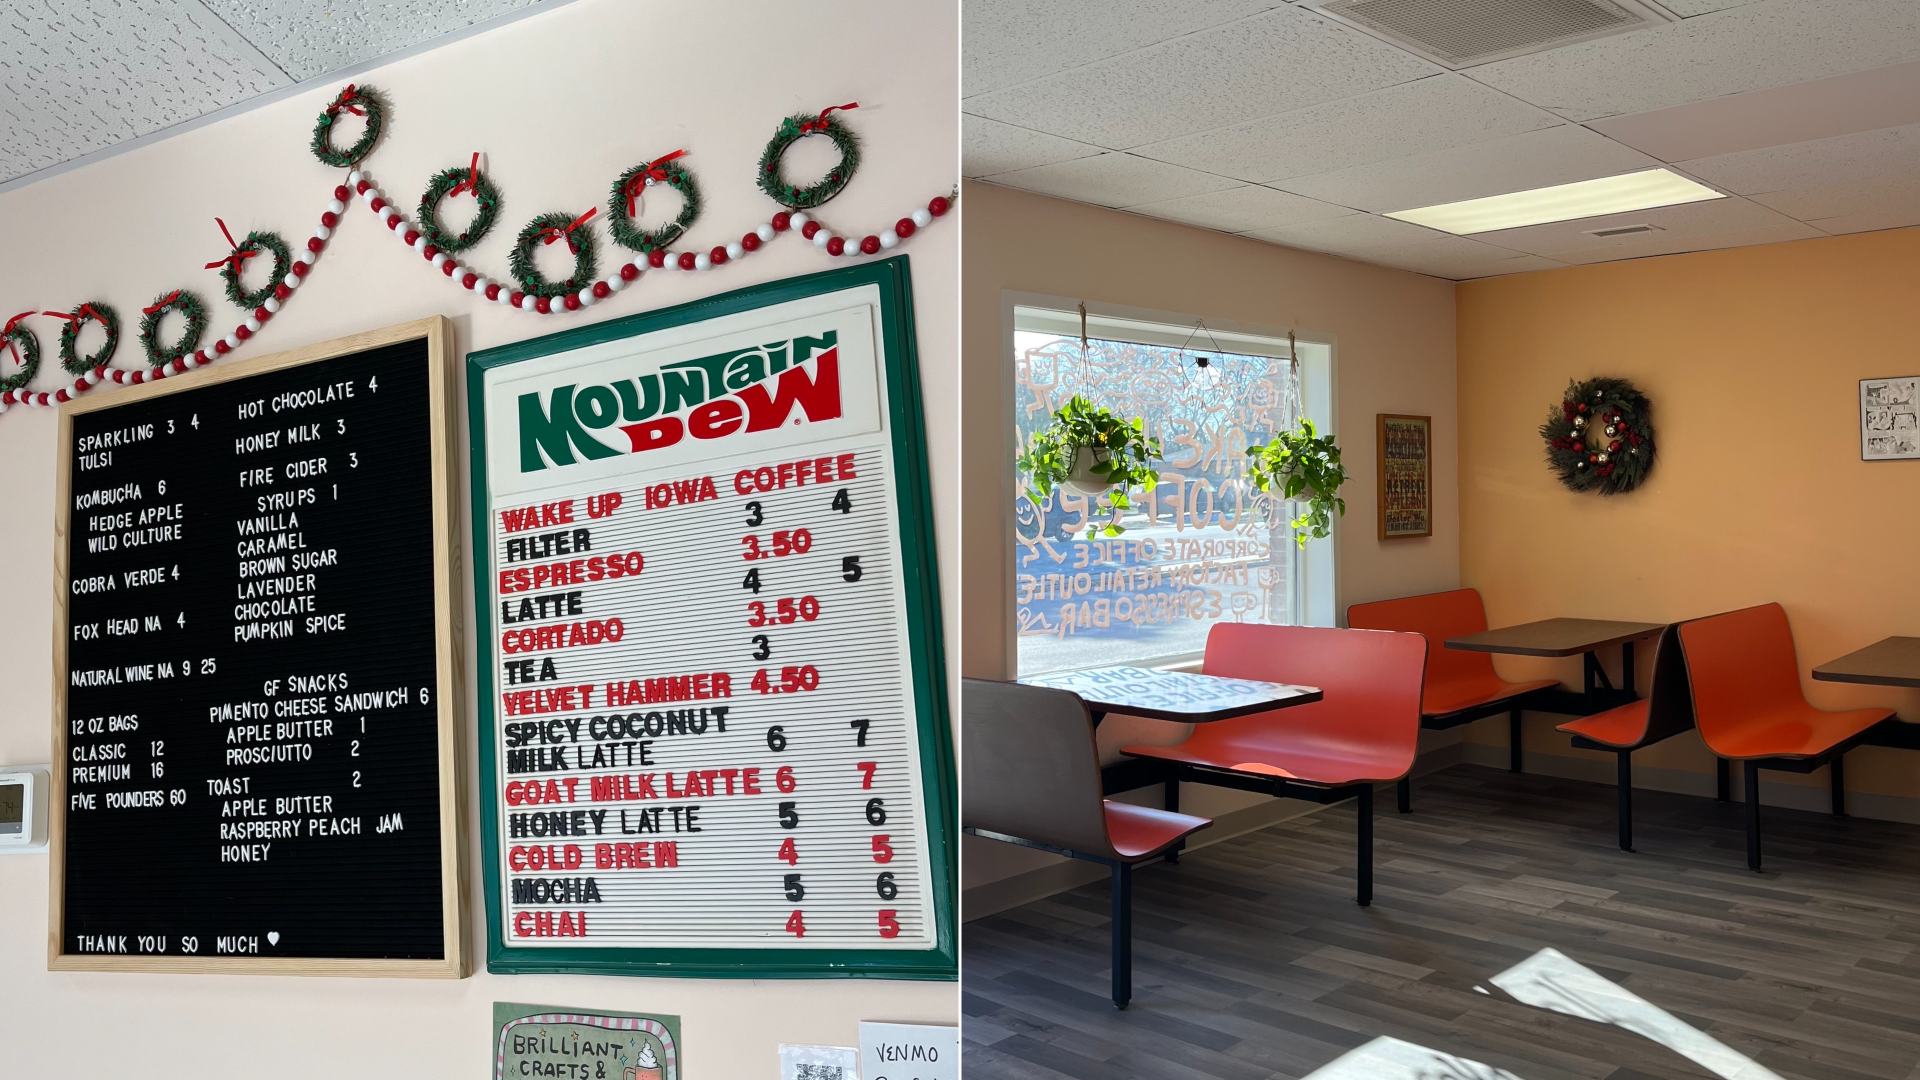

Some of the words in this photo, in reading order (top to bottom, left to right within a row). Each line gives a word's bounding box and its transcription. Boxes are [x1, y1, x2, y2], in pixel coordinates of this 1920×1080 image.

[239, 399, 264, 419] HOT
[272, 381, 354, 412] CHOCOLATE
[369, 376, 377, 392] 4
[79, 424, 153, 452] SPARKLING
[168, 420, 174, 434] 3
[191, 414, 199, 429] 4
[236, 430, 280, 454] HONEY
[288, 424, 320, 444] MILK
[338, 419, 345, 434] 3
[79, 451, 111, 471] TULSI
[240, 467, 273, 487] FIRE
[286, 458, 327, 478] CIDER
[350, 453, 358, 468] 3
[77, 483, 141, 510] KOMBUCHA
[159, 480, 165, 495] 6
[258, 488, 315, 512] SYRUPS
[333, 484, 336, 500] 1
[502, 500, 573, 533] WAKE
[588, 493, 622, 519] UP
[646, 477, 717, 510] IOWA
[734, 453, 856, 496] COFFEE
[90, 512, 132, 531] HEDGE
[139, 504, 183, 525] APPLE
[237, 512, 298, 536] VANILLA
[507, 528, 591, 562] FILTER
[746, 502, 763, 527] 3
[832, 489, 851, 514] 4
[88, 535, 117, 553] WILD
[123, 524, 181, 548] CULTURE
[238, 532, 307, 558] CARAMEL
[240, 556, 285, 578] BROWN
[292, 549, 337, 571] SUGAR
[499, 551, 644, 594] ESPRESSO
[743, 529, 811, 561] 3.50
[73, 575, 115, 594] COBRA
[124, 568, 165, 588] VERDE
[172, 565, 179, 580] 4
[238, 574, 316, 600] LAVENDER
[503, 591, 582, 623] LATTE
[743, 568, 761, 593] 4
[843, 556, 861, 582] 5
[235, 595, 316, 621] CHOCOLATE
[75, 623, 98, 640] FOX
[108, 619, 138, 635] HEAD
[145, 616, 161, 632] NA
[177, 612, 185, 628] 4
[235, 620, 293, 642] PUMPKIN
[306, 614, 345, 634] SPICE
[502, 617, 624, 655] CORTADO
[748, 596, 819, 627] 3.50
[72, 667, 122, 687] NATURAL
[125, 665, 154, 682] WINE
[158, 662, 174, 678] NA
[183, 661, 190, 676] 9
[201, 658, 216, 674] 25
[505, 658, 557, 684] TEA
[752, 635, 770, 660] 3
[264, 680, 280, 696] GF
[288, 673, 348, 693] SNACKS
[503, 685, 593, 716] VELVET
[607, 673, 731, 707] HAMMER
[751, 666, 819, 695] 4.50
[210, 701, 268, 722] PIMENTO
[275, 697, 327, 717] CHEESE
[335, 687, 407, 712] SANDWICH
[420, 688, 429, 705] 6
[72, 720, 83, 735] 12
[89, 718, 104, 733] OZ
[109, 715, 138, 732] BAGS
[227, 725, 271, 744] APPLE
[277, 720, 332, 740] BUTTER
[361, 717, 364, 733] 1
[505, 718, 580, 747] SPICY
[589, 707, 728, 740] COCONUT
[73, 743, 126, 761] CLASSIC
[151, 741, 163, 757] 12
[227, 744, 311, 765] PROSCIUTTO
[351, 740, 359, 756] 2
[508, 746, 568, 773] MILK
[578, 741, 653, 769] LATTE
[767, 726, 786, 752] 6
[851, 720, 869, 747] 7
[73, 764, 130, 783] PREMIUM
[151, 762, 163, 778] 16
[207, 777, 250, 796] TOAST
[353, 771, 361, 787] 2
[506, 778, 578, 806] GOAT
[591, 774, 657, 802] MILK
[666, 768, 760, 798] LATTE
[776, 767, 795, 793] 6
[857, 762, 876, 789] 7
[72, 792, 96, 811] FIVE
[106, 790, 164, 808] POUNDERS
[170, 789, 186, 806] 60
[222, 798, 267, 817] APPLE
[276, 796, 332, 815] BUTTER
[221, 819, 301, 840] RASPBERRY
[310, 817, 360, 836] PEACH
[376, 813, 403, 833] JAM
[511, 810, 605, 838] HONEY
[621, 806, 700, 834] LATTE
[779, 802, 798, 829] 5
[866, 798, 886, 826] 6
[222, 843, 270, 862] HONEY
[509, 845, 582, 871] COLD
[595, 842, 677, 869] BREW
[779, 838, 797, 865] 4
[872, 835, 892, 864] 5
[513, 878, 600, 903] MOCHA
[784, 874, 804, 901] 5
[877, 872, 897, 900] 6
[515, 912, 585, 937] CHAI
[786, 911, 804, 938] 4
[878, 910, 899, 938] 5
[78, 935, 126, 953] THANK
[138, 936, 165, 952] YOU
[182, 936, 198, 953] SO
[218, 936, 257, 953] MUCH
[876, 1043, 939, 1063] VENMO
[519, 1060, 590, 1080] CRAFTS
[595, 1060, 607, 1080] &
